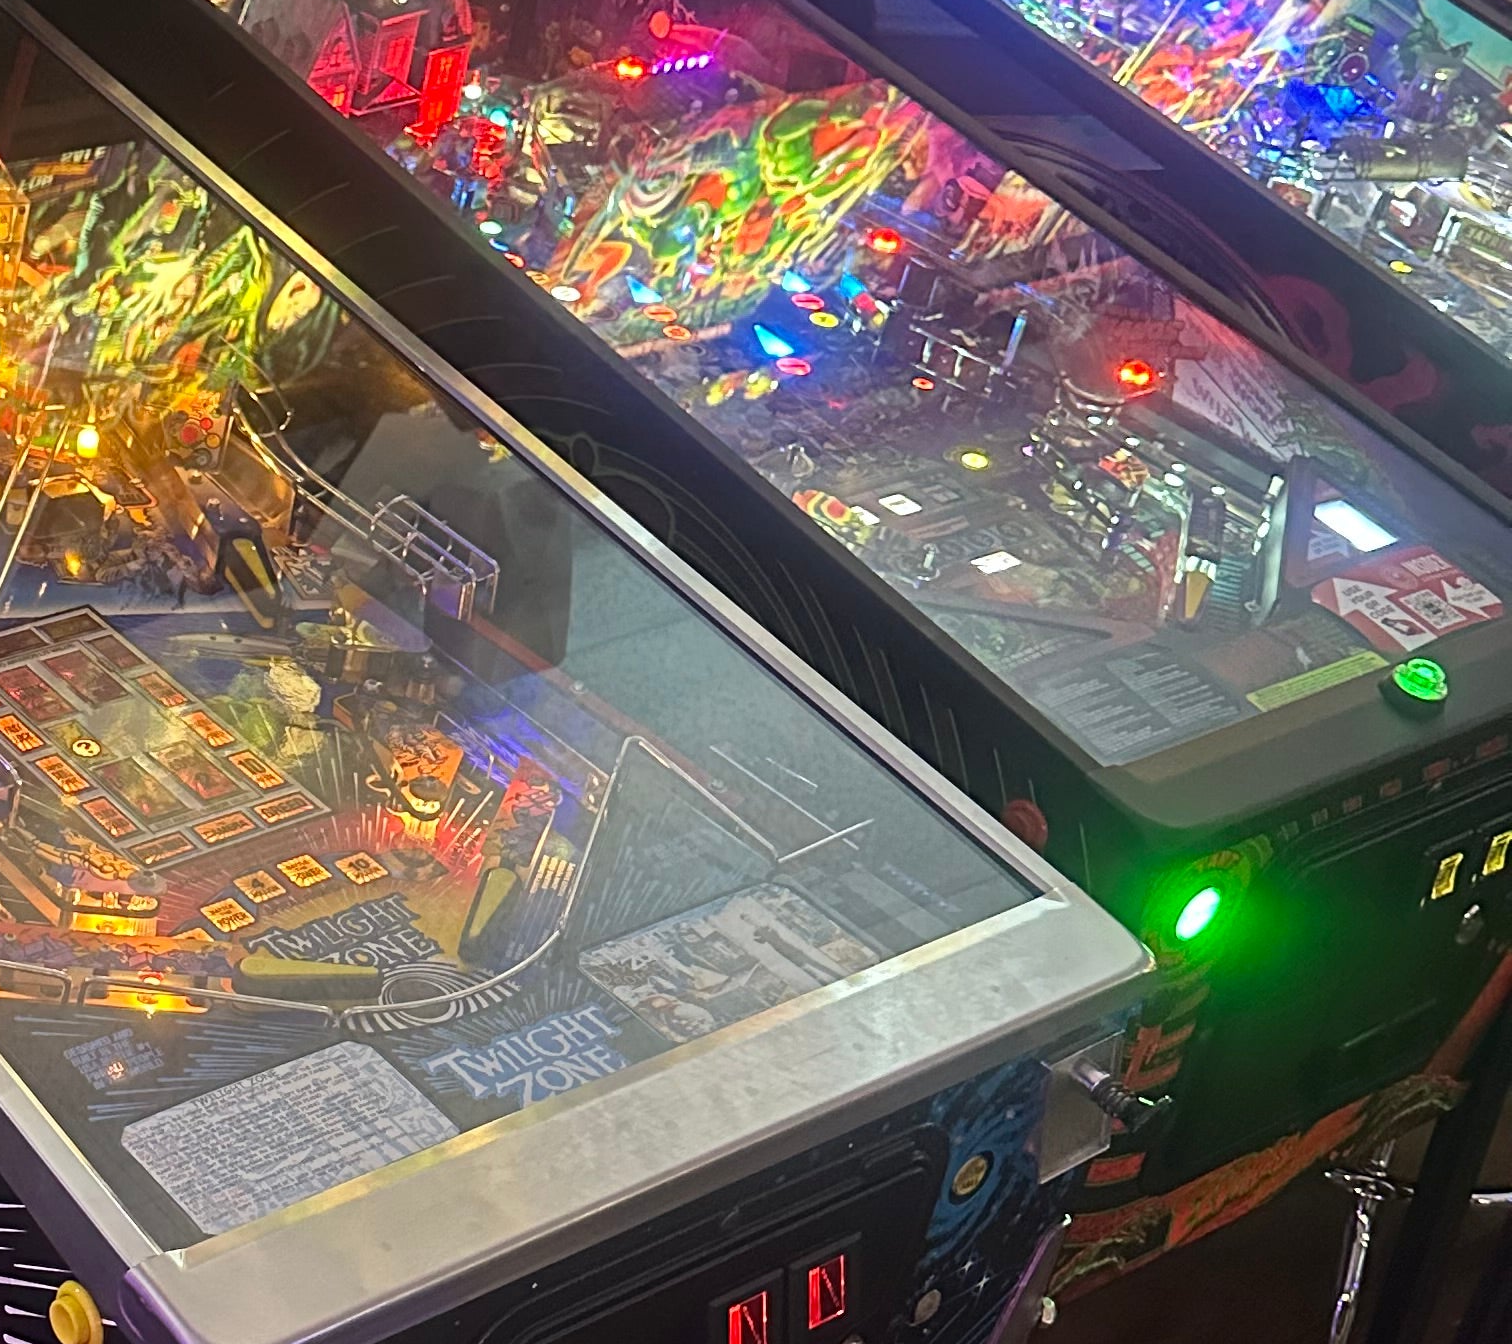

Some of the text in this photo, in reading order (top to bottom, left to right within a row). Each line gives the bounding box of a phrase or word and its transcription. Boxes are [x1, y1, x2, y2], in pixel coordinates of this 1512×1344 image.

[348, 858, 371, 870] 10
[248, 893, 418, 960] TWILIGHT
[317, 928, 437, 967] ZONE
[426, 1006, 620, 1097] TWILIGHT
[494, 1045, 628, 1109] ZONE
[249, 1068, 279, 1088] ZONE
